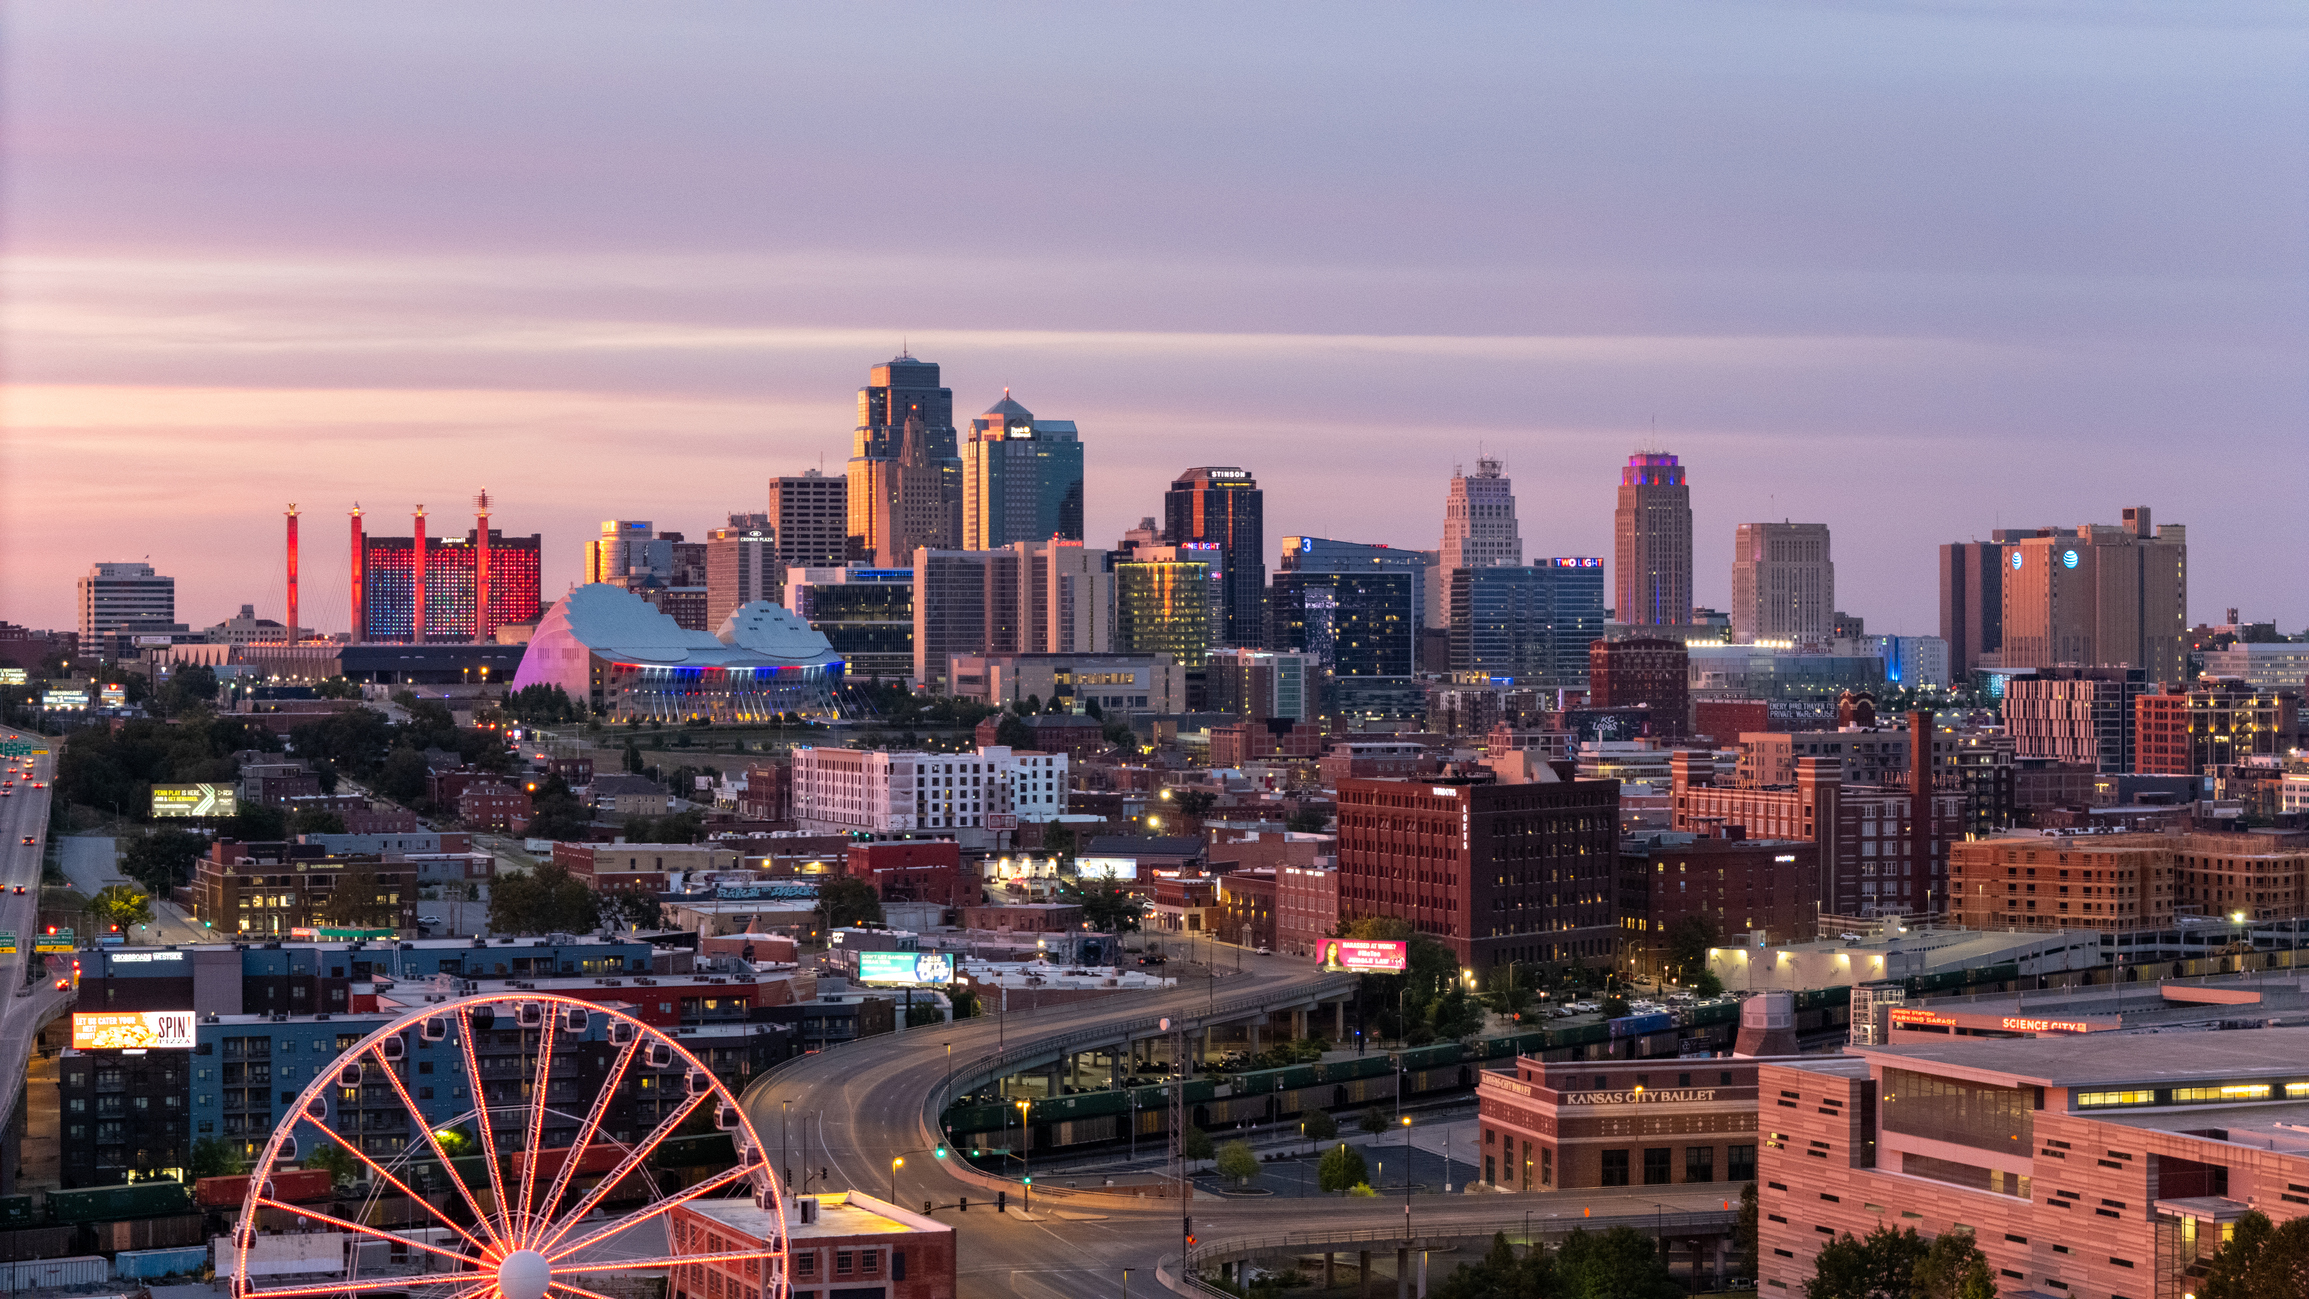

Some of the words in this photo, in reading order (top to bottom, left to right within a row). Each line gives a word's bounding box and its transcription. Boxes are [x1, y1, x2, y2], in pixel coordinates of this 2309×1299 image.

[1302, 538, 1312, 553] 3
[1555, 558, 1577, 567] TWO
[1577, 558, 1603, 567] LIGHT
[1770, 710, 1793, 718] PRIVATE
[1795, 710, 1835, 718] WAREHOUSE
[1600, 715, 1615, 724] KC
[112, 954, 152, 962] CROSSROADS
[152, 952, 183, 960] WESTSIDE
[98, 1017, 117, 1025] CATER
[119, 1016, 136, 1024] YOUR
[1892, 1015, 1925, 1023] PARKING
[1926, 1017, 1957, 1026] GARAGE
[2002, 1018, 2049, 1031] SCIENCE
[2051, 1022, 2076, 1031] CITY
[158, 1016, 191, 1039] SPIN!
[1567, 1093, 1623, 1105] KANSAS
[1626, 1092, 1658, 1103] CITY
[1661, 1090, 1716, 1102] BALLET
